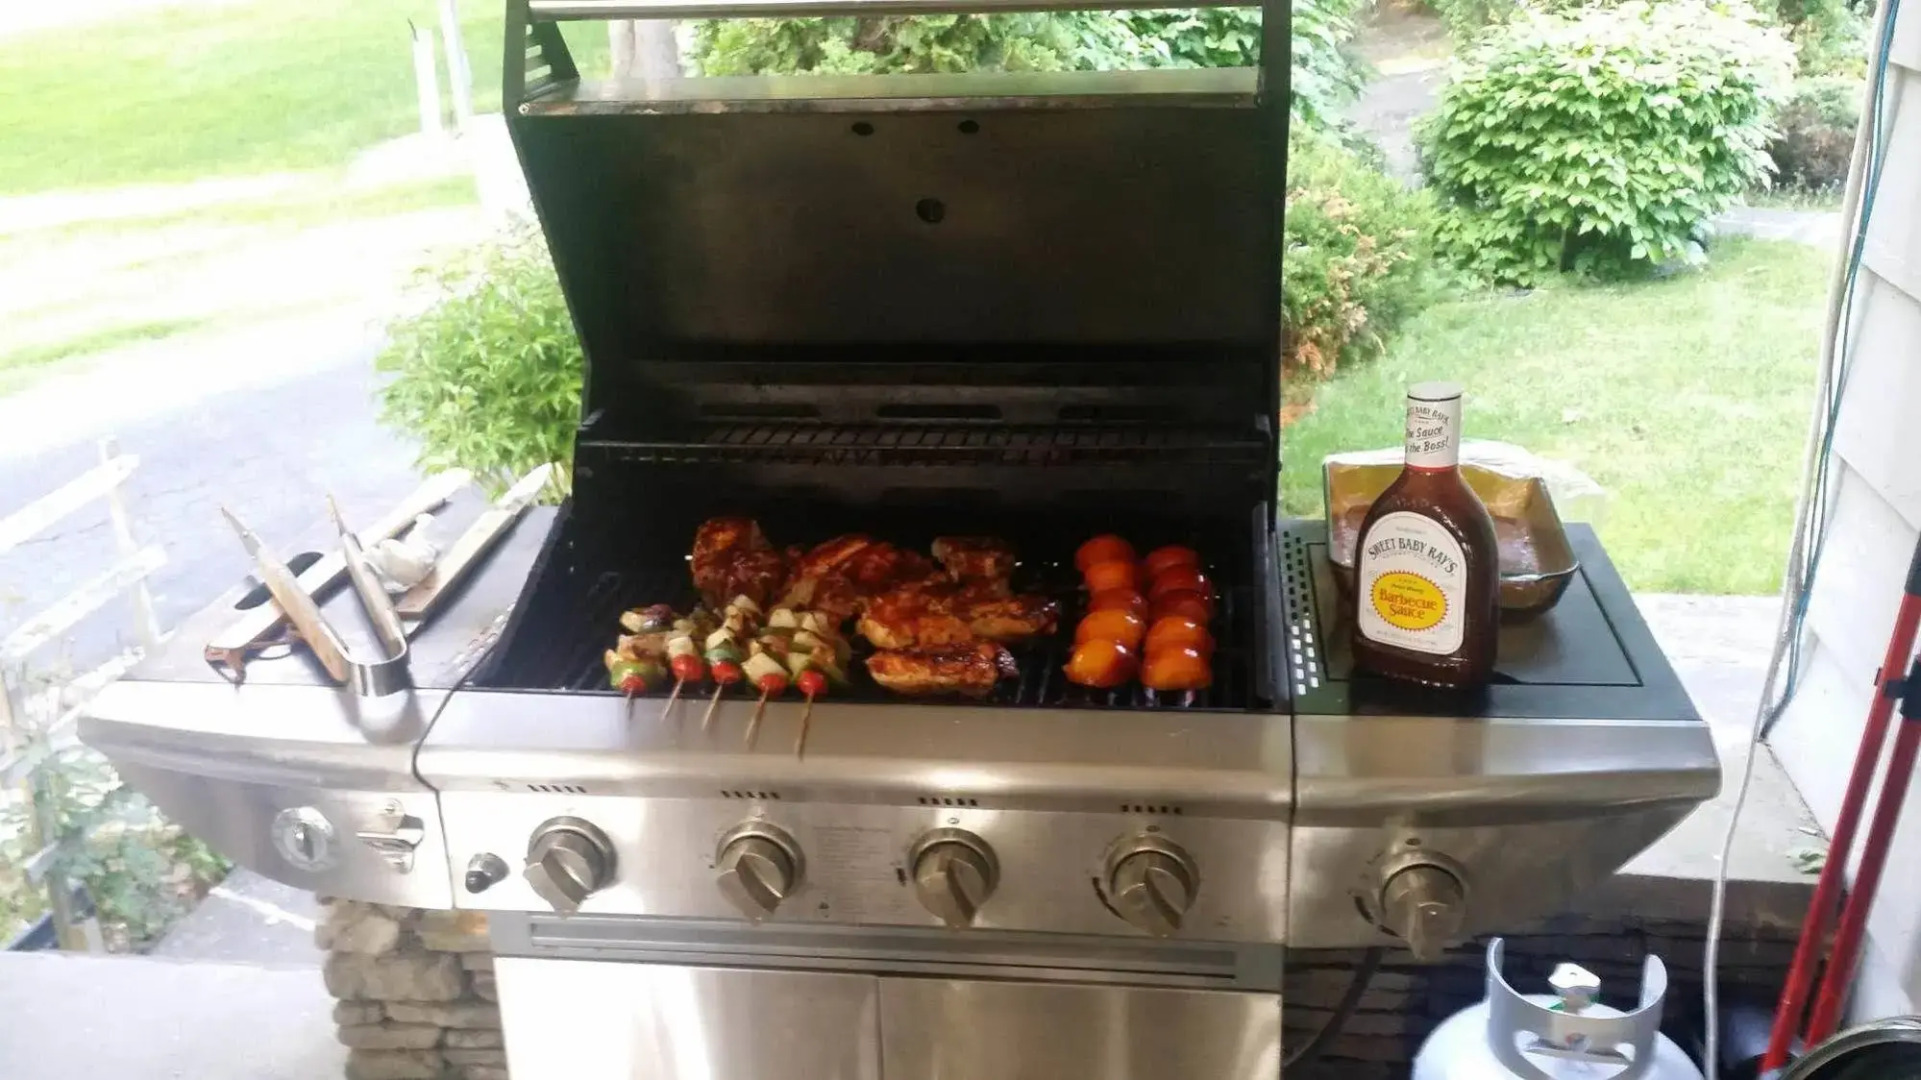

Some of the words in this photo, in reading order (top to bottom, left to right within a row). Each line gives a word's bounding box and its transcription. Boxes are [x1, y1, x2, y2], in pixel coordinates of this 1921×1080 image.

[1416, 425, 1443, 438] Sauce
[1409, 442, 1421, 453] the
[1423, 436, 1450, 452] Boss!
[1368, 538, 1396, 560] SWEET
[1398, 537, 1427, 552] BABY
[1427, 546, 1458, 573] RAY'S
[1379, 588, 1437, 611] Barbecue
[1389, 604, 1426, 620] Sauce
